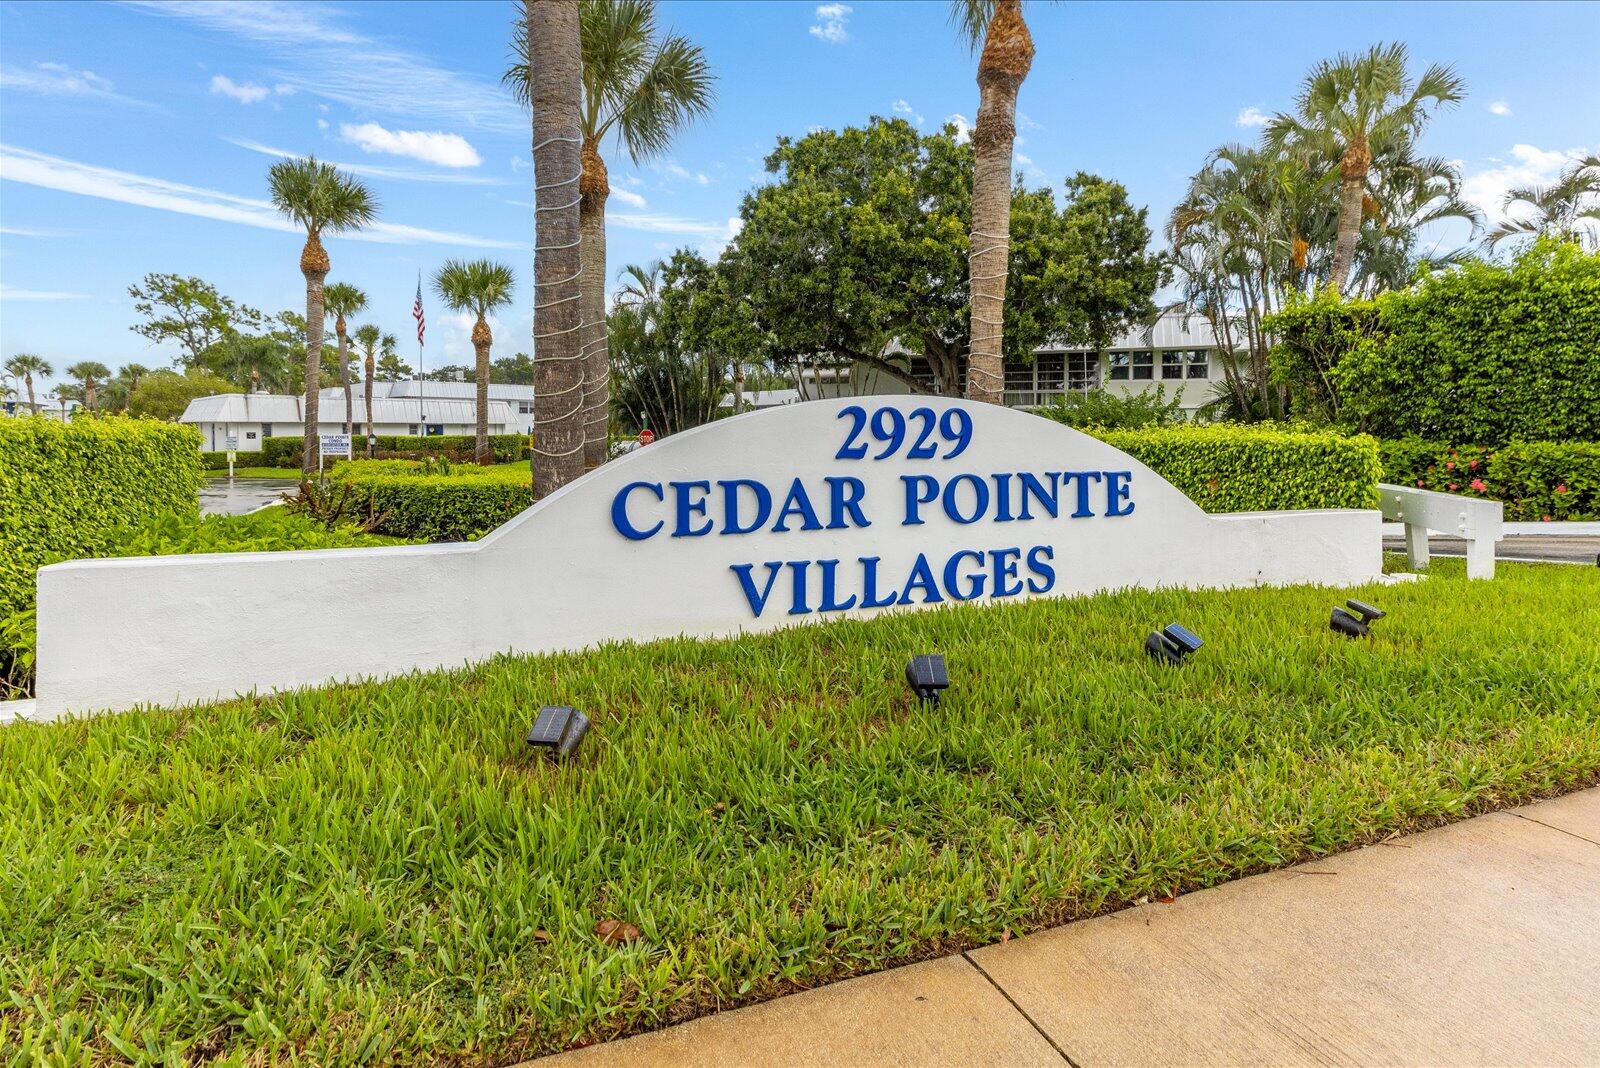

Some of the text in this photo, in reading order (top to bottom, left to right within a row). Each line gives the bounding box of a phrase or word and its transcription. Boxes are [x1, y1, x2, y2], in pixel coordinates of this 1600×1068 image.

[640, 435, 654, 443] STOP
[835, 405, 973, 461] 2929
[611, 470, 1136, 541] CEDAR POINTE
[730, 545, 1056, 618] VILLAGES
